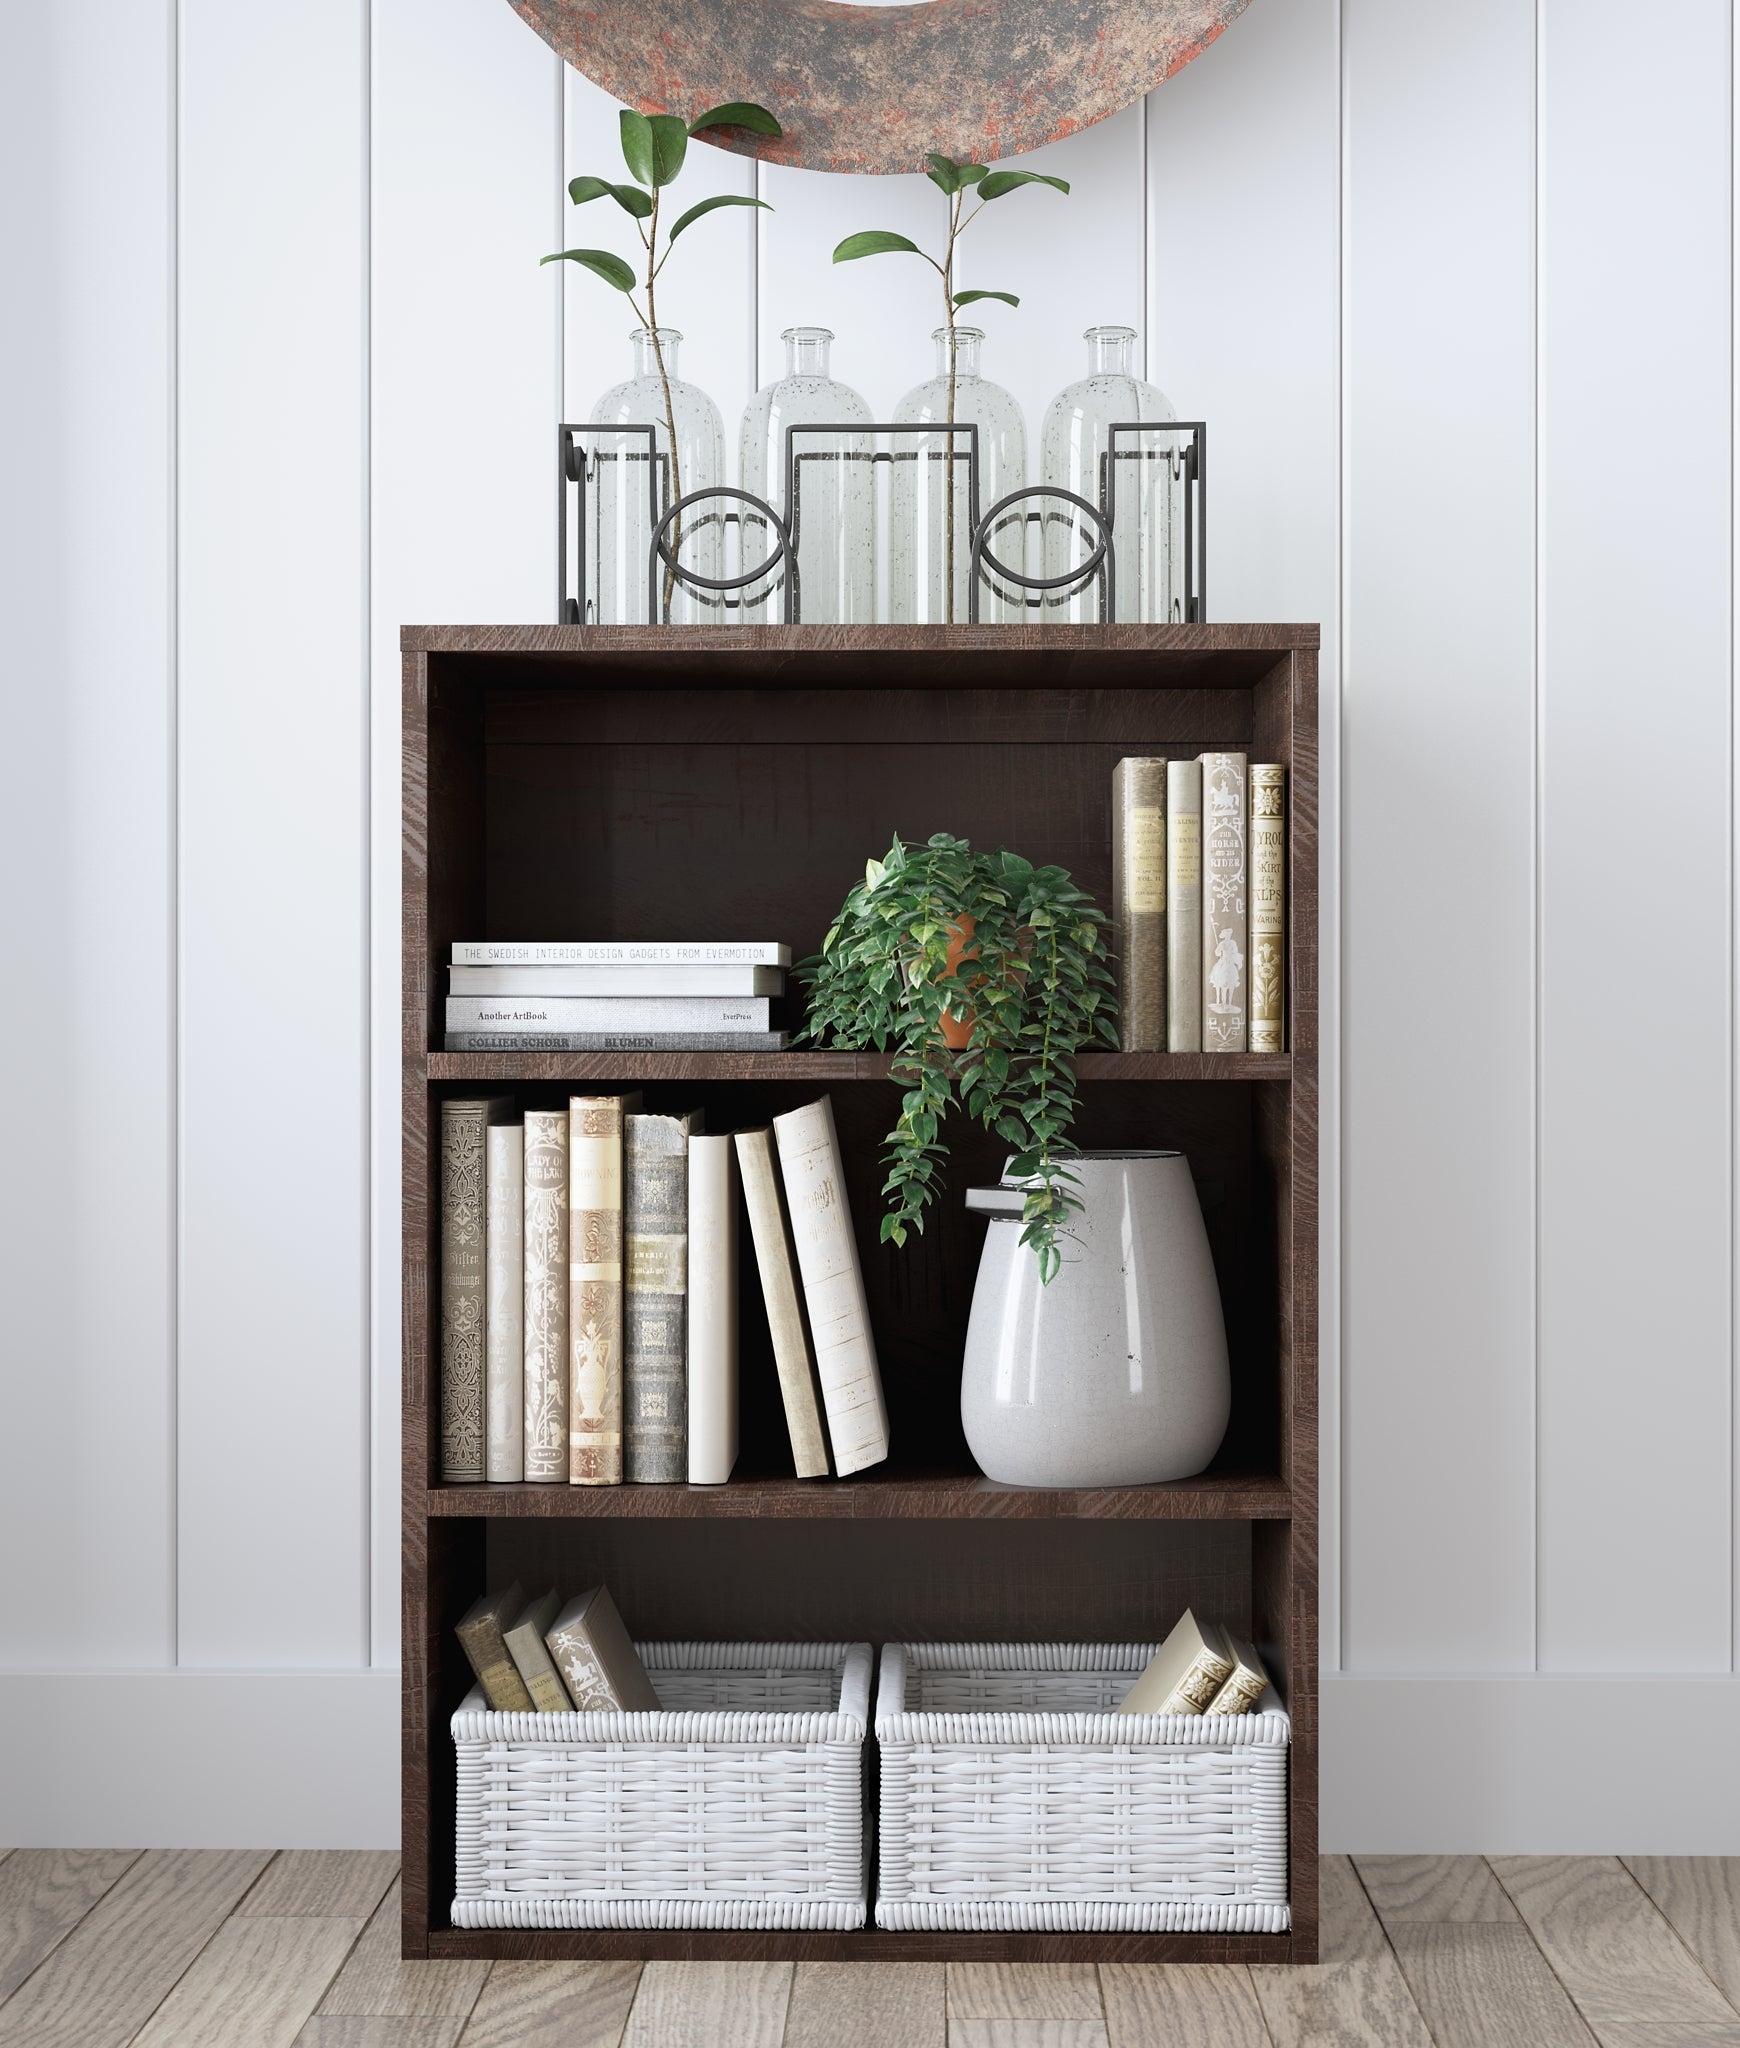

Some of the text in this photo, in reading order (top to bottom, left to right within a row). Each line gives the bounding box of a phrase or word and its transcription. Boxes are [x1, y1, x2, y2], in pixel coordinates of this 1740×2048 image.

[1211, 839, 1239, 848] HORSE
[1256, 831, 1283, 849] YROL
[1210, 857, 1240, 867] RIDER
[465, 948, 765, 959] THE SWEDISH INTERIOR DESIGN GADGETS FROM EVERMOTION
[478, 1012, 548, 1020] Another ArtBook
[722, 1013, 752, 1021] EverPress
[468, 1038, 570, 1048] COLLIER SCHORR
[604, 1038, 654, 1048] BLUMEN
[527, 1155, 551, 1166] LADY
